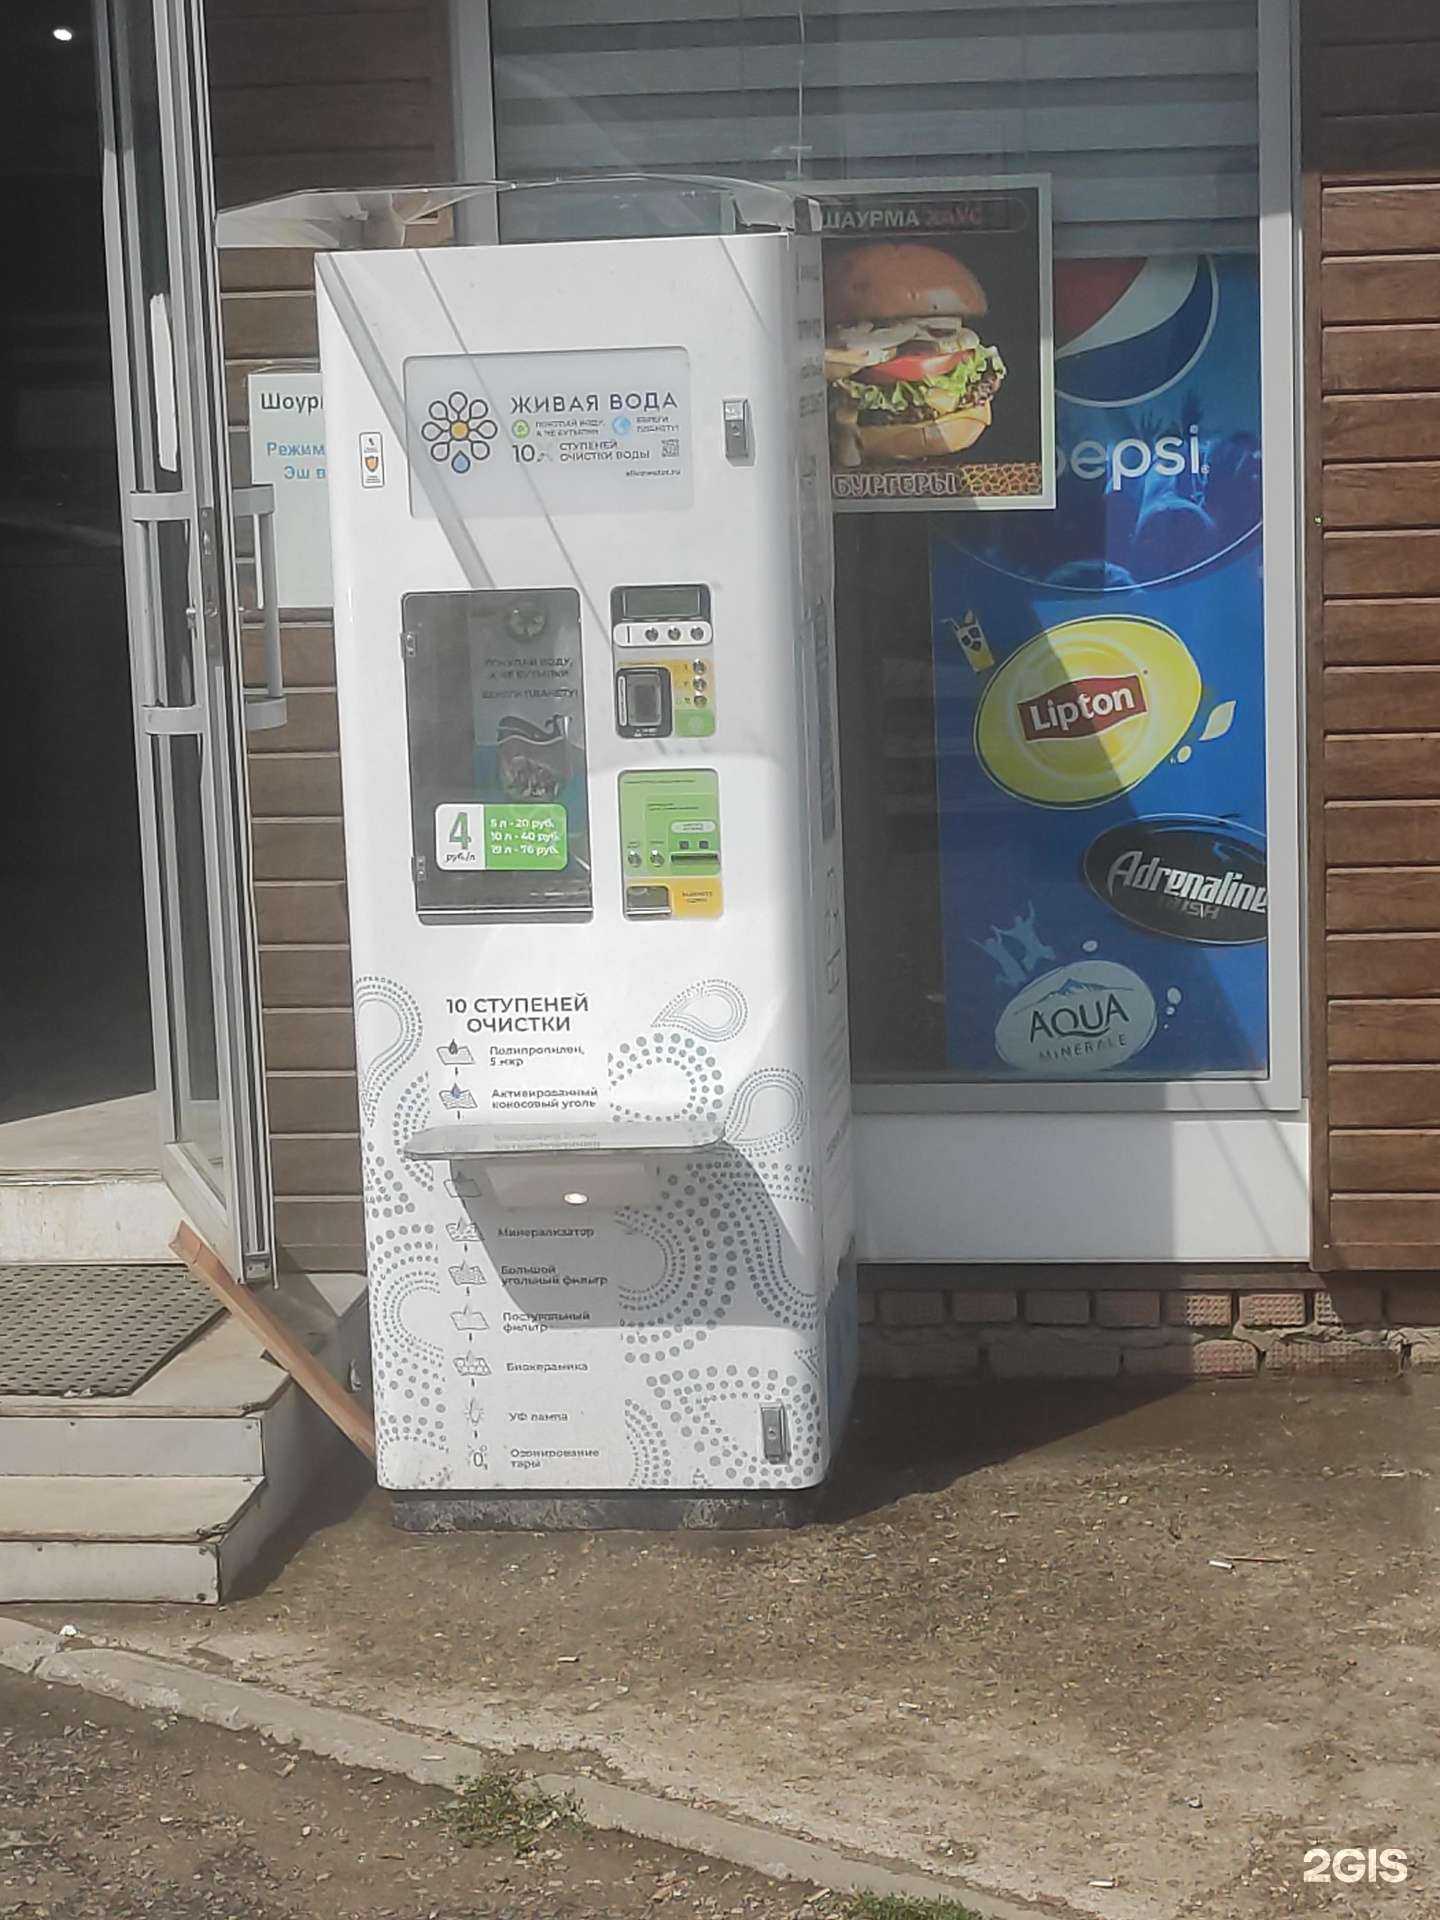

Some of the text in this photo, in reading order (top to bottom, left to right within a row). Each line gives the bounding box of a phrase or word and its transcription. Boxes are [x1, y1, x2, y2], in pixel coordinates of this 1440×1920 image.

[261, 392, 324, 415] Шоур
[510, 392, 678, 414] ЖИВАЯ ВОДА
[266, 441, 326, 457] Режим
[560, 439, 618, 451] СТУПЕНЕЙ
[511, 443, 536, 463] 10
[560, 450, 650, 462] ОЧИСТКИ ВОДЫ
[284, 466, 309, 479] Эш
[833, 472, 958, 497] БУРГЕРЫ
[1029, 685, 1135, 733] Lipton
[448, 811, 472, 850] 4
[446, 992, 589, 1014] 10 СТУПЕНЕЙ
[1029, 992, 1129, 1043] AQUA
[467, 1016, 571, 1032] ОЧИСТКИ
[489, 1057, 496, 1066] 5
[491, 1087, 599, 1099] Активированный
[491, 1098, 597, 1110] кокосовый уголь
[497, 1227, 594, 1239] Минерализатор
[501, 1264, 556, 1275] Большой
[501, 1274, 608, 1287] угольный фильтр
[503, 1323, 548, 1334] фильтр
[506, 1361, 588, 1373] Биокерамика
[508, 1412, 568, 1422] УФ лампа
[510, 1449, 599, 1459] Озонирование
[511, 1460, 541, 1469] тары
